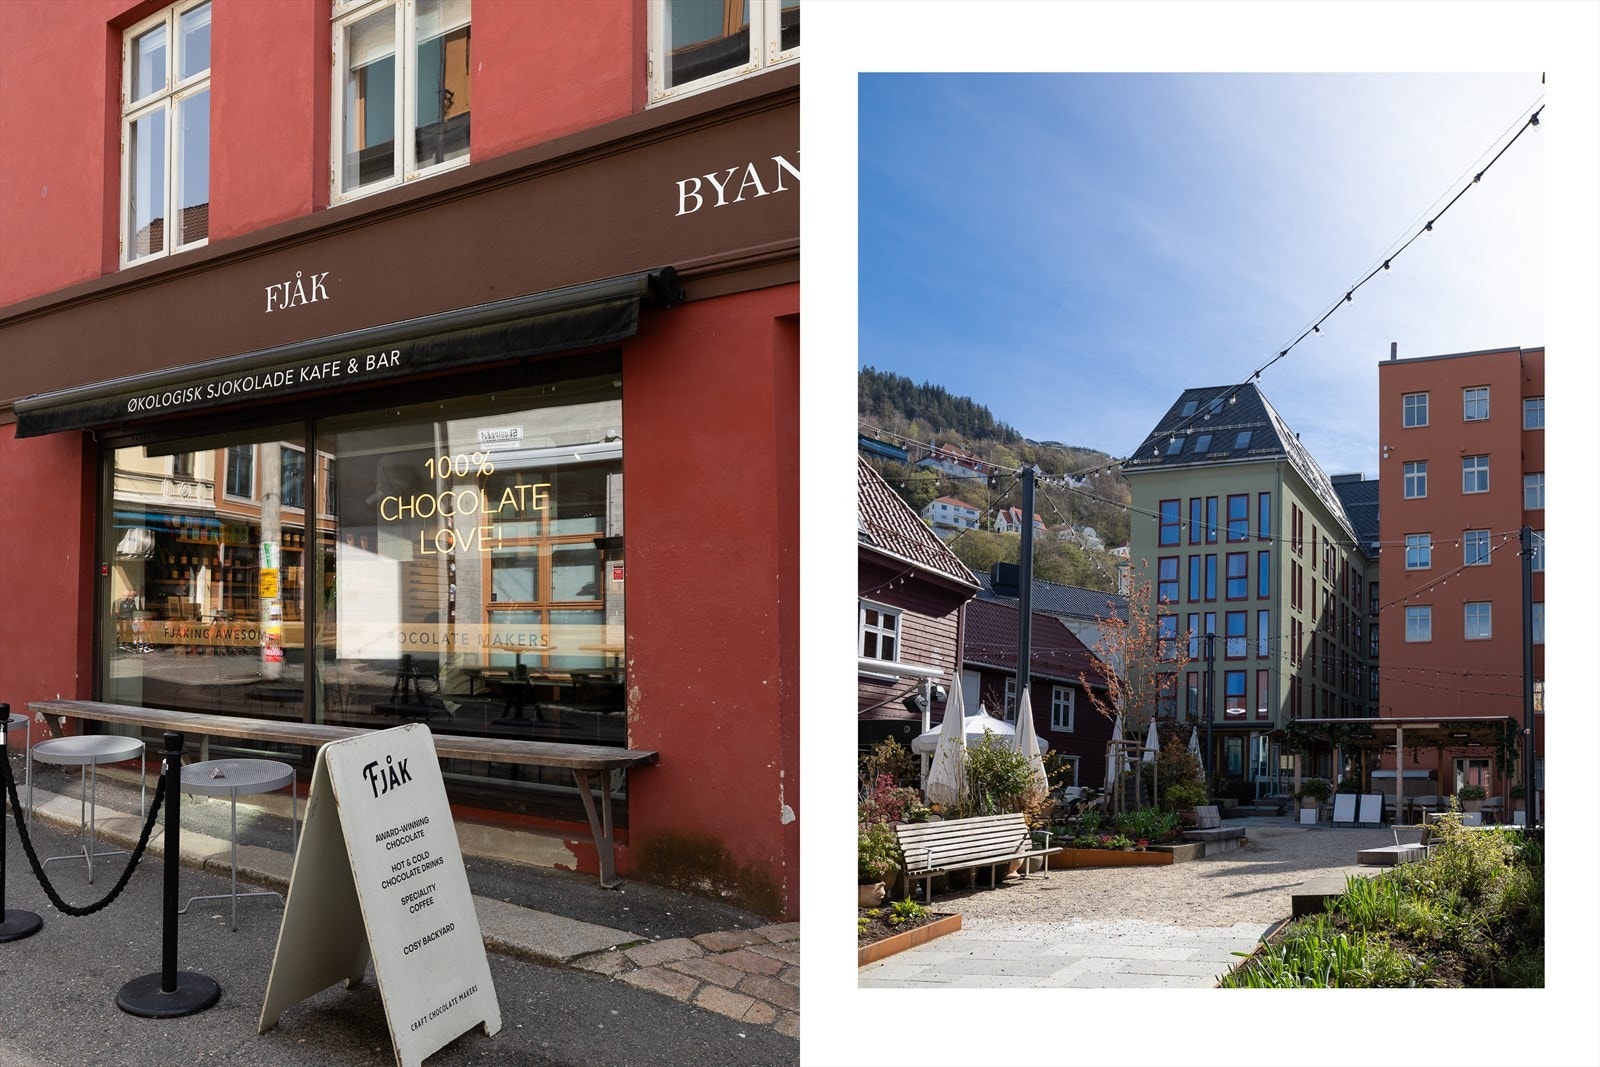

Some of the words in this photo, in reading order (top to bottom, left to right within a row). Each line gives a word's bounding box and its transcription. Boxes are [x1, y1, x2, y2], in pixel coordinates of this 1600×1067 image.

[675, 151, 800, 216] BYAN
[265, 271, 329, 313] FJÅK
[127, 386, 203, 412] ØKOLOGISK
[206, 369, 294, 399] SJOKOLADE
[299, 361, 341, 383] KAFE
[347, 358, 358, 374] &
[365, 350, 400, 371] BAR
[424, 451, 495, 479] 100%
[380, 483, 551, 521] CHOCOLATE
[420, 526, 503, 555] LOVE!
[215, 628, 269, 641] AWESOM
[376, 631, 469, 646] HOCOLATE
[478, 633, 549, 647] MAKERS
[362, 754, 412, 798] FJÅK
[375, 816, 430, 843] AWARD-WINNING
[385, 829, 425, 851] CHOCOLATE
[381, 866, 422, 889] CHOCOLATE
[421, 856, 444, 872] DRINKS
[391, 860, 405, 873] HOT
[406, 858, 412, 867] &
[412, 851, 430, 864] COLD
[400, 883, 437, 906] SPECIALITY
[409, 896, 434, 914] COFFEE
[403, 939, 422, 955] COSY
[422, 922, 455, 946] BACKYARD
[410, 1015, 428, 1032] CRAFT
[428, 997, 458, 1020] CHOCOLATE
[458, 984, 478, 1001] MAKERS
